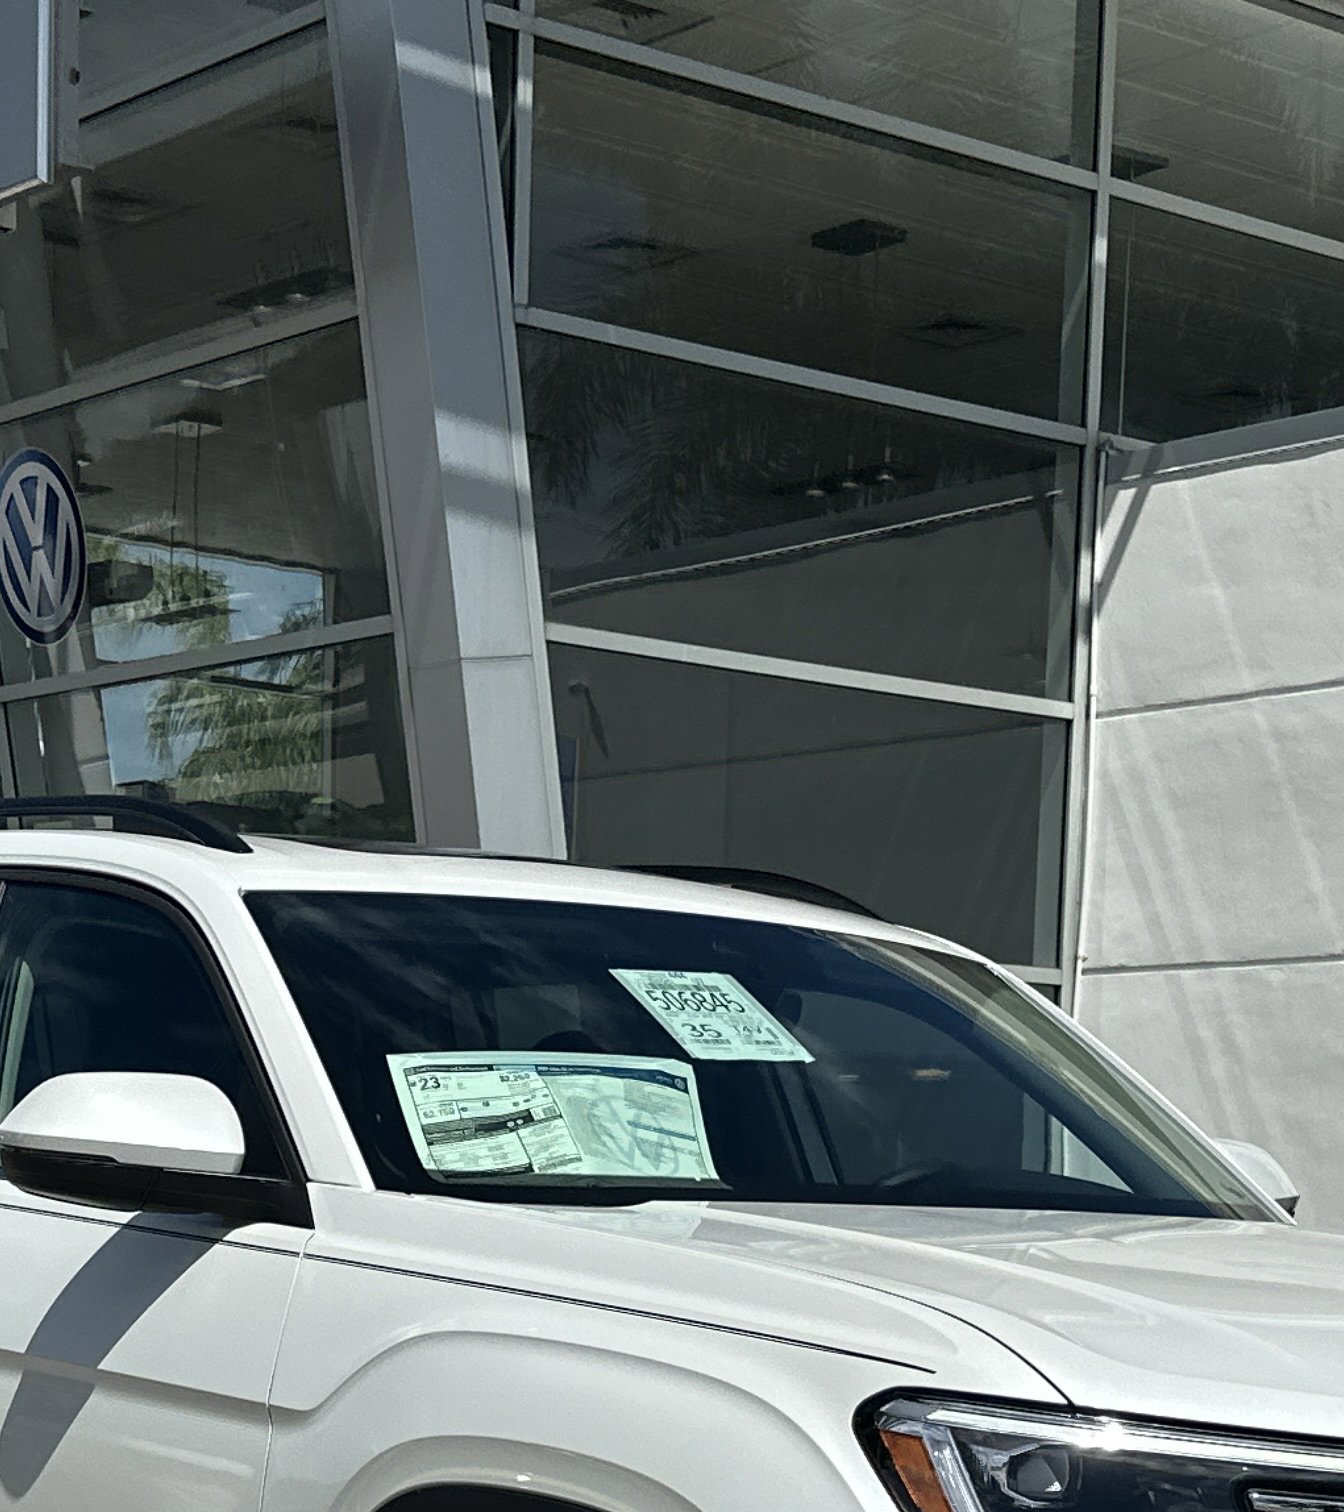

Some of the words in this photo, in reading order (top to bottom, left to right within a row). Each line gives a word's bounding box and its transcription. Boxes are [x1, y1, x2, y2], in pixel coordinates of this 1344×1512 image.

[645, 989, 746, 1014] 506845
[681, 1022, 723, 1039] 35
[417, 1075, 442, 1091] 23
